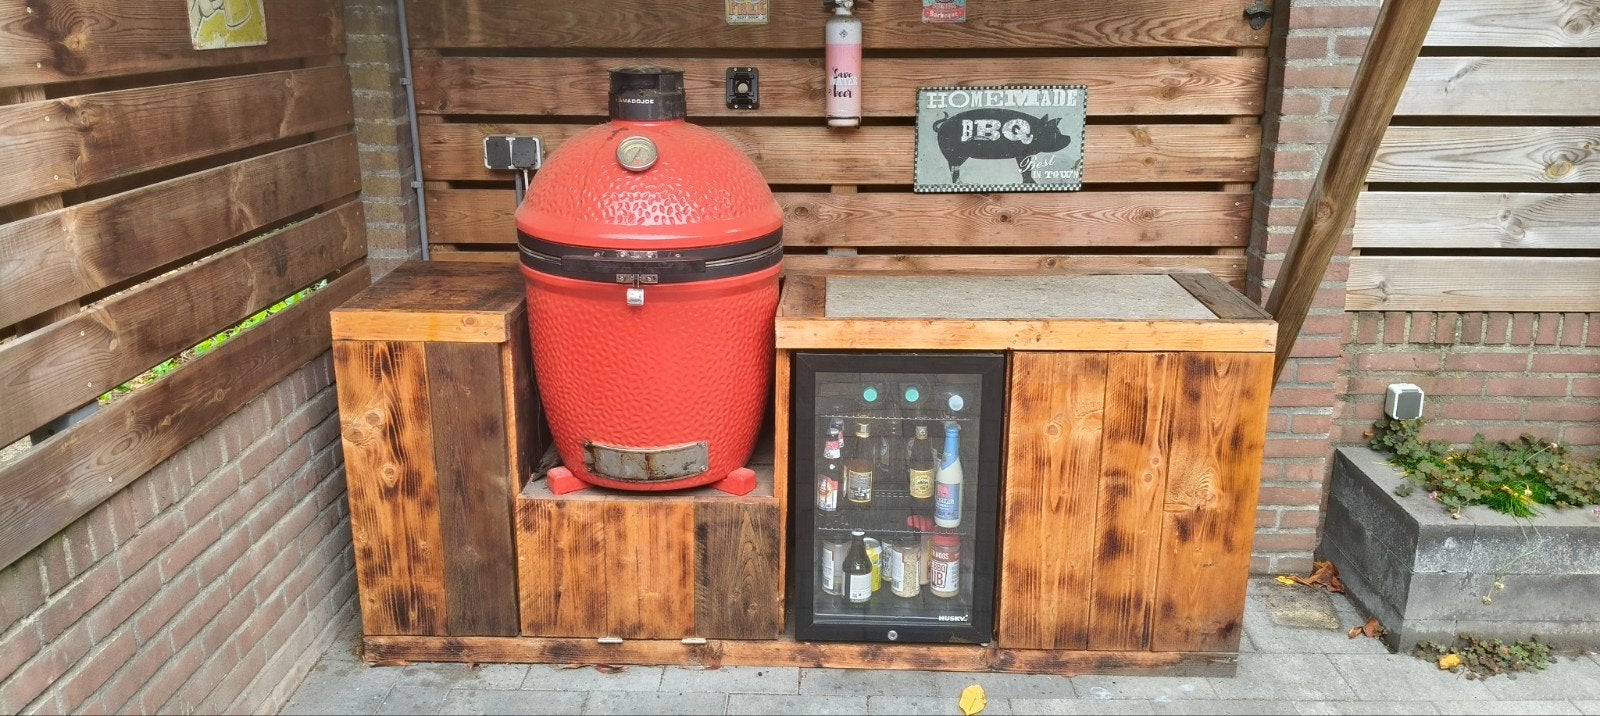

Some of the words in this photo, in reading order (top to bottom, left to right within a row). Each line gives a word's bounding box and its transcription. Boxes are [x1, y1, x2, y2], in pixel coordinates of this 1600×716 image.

[832, 67, 853, 79] Save
[833, 84, 853, 99] beer
[926, 88, 1079, 109] HOMEMADE
[616, 97, 654, 105] AMADOJOE
[961, 118, 1034, 145] BBQ
[1018, 155, 1057, 173] Best
[938, 614, 966, 622] HUSKY
